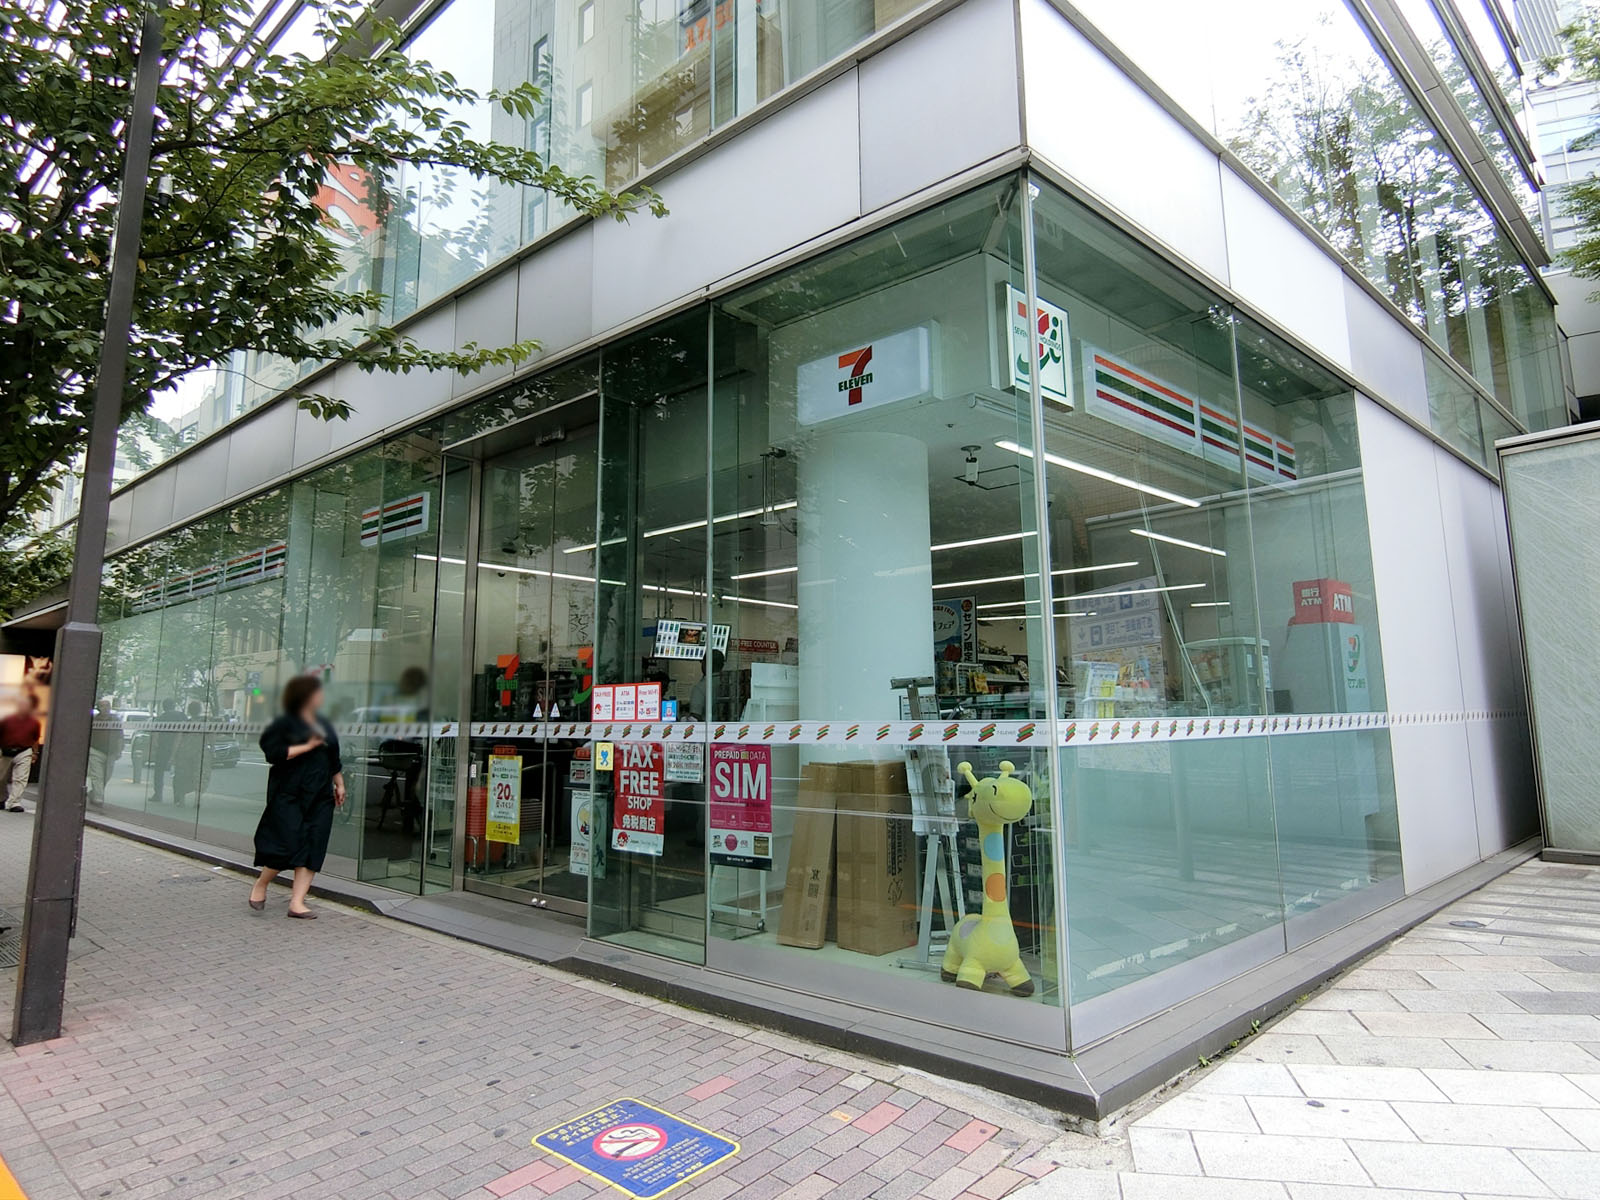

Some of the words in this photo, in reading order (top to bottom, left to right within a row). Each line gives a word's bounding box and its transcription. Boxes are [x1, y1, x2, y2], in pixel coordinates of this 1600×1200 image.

[1301, 597, 1322, 606] ATM
[1333, 593, 1353, 613] ATM
[963, 612, 973, 662] セブン限定
[714, 750, 740, 760] PREPAID
[749, 751, 766, 760] DATA
[619, 770, 659, 796] FREE
[714, 761, 767, 800] SIM
[627, 796, 653, 810] SHOP
